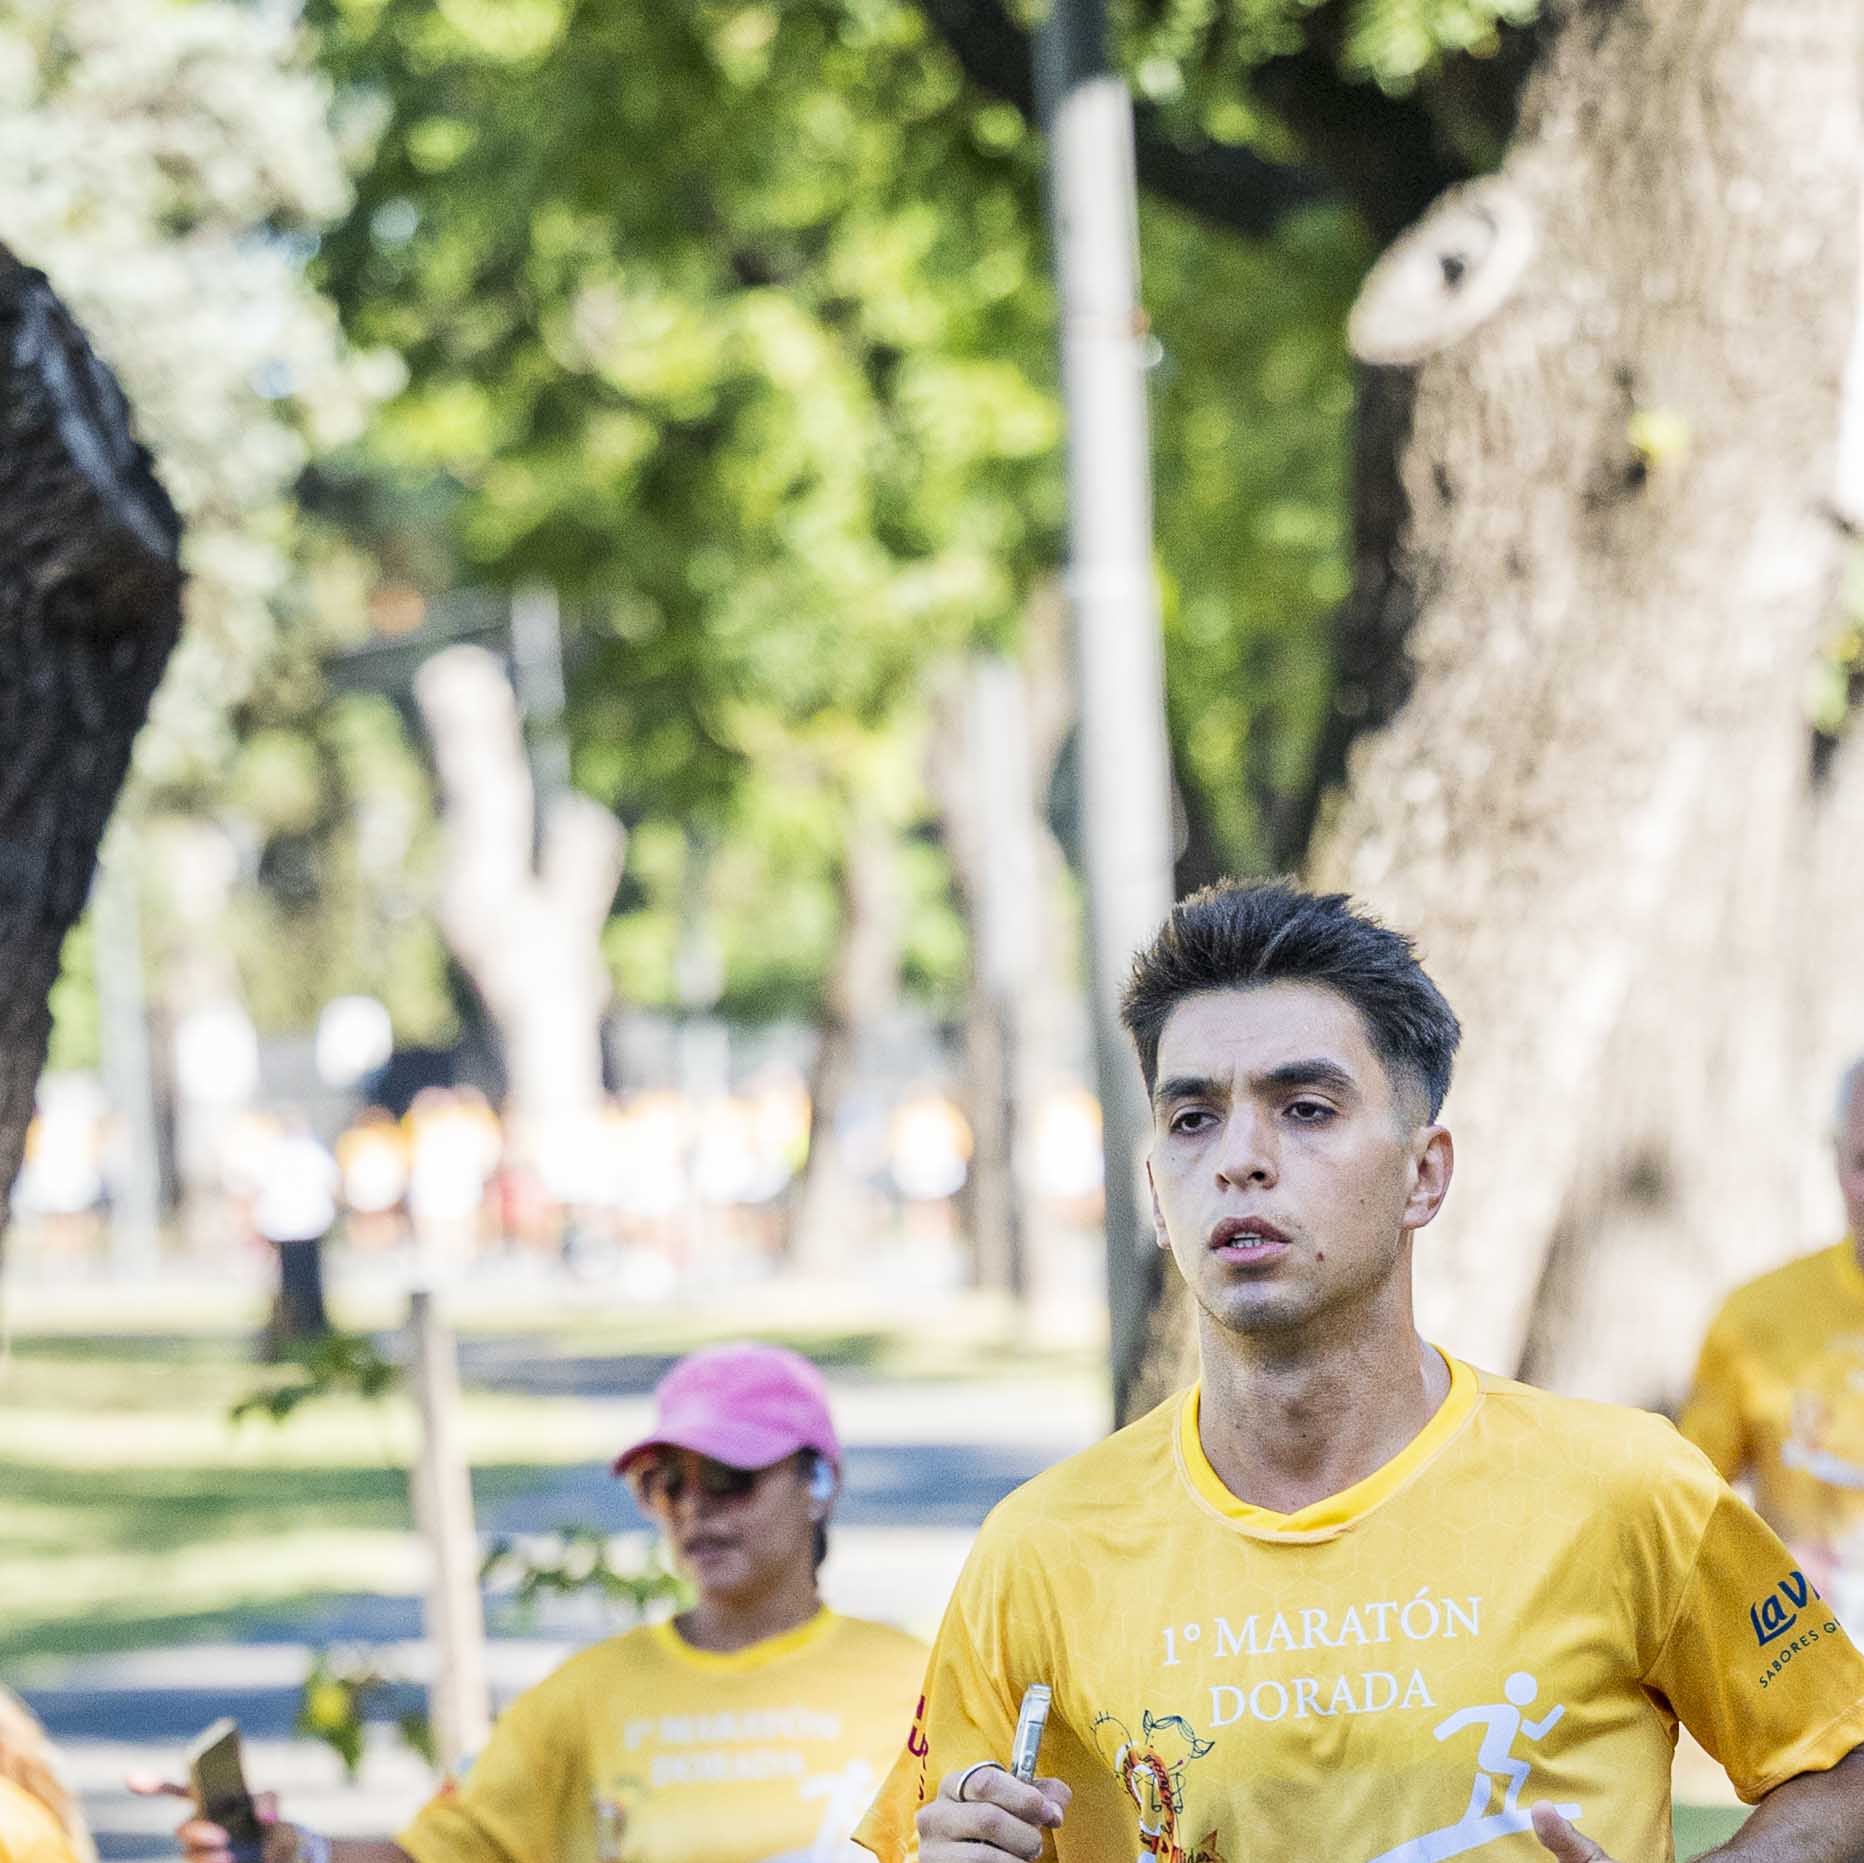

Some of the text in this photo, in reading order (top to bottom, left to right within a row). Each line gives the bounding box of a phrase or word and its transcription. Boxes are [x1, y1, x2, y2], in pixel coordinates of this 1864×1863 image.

[1214, 1586, 1483, 1657] MARATÓN
[1750, 1571, 1821, 1647] LaV
[1759, 1630, 1819, 1689] SABORES
[1208, 1668, 1437, 1728] DORADA
